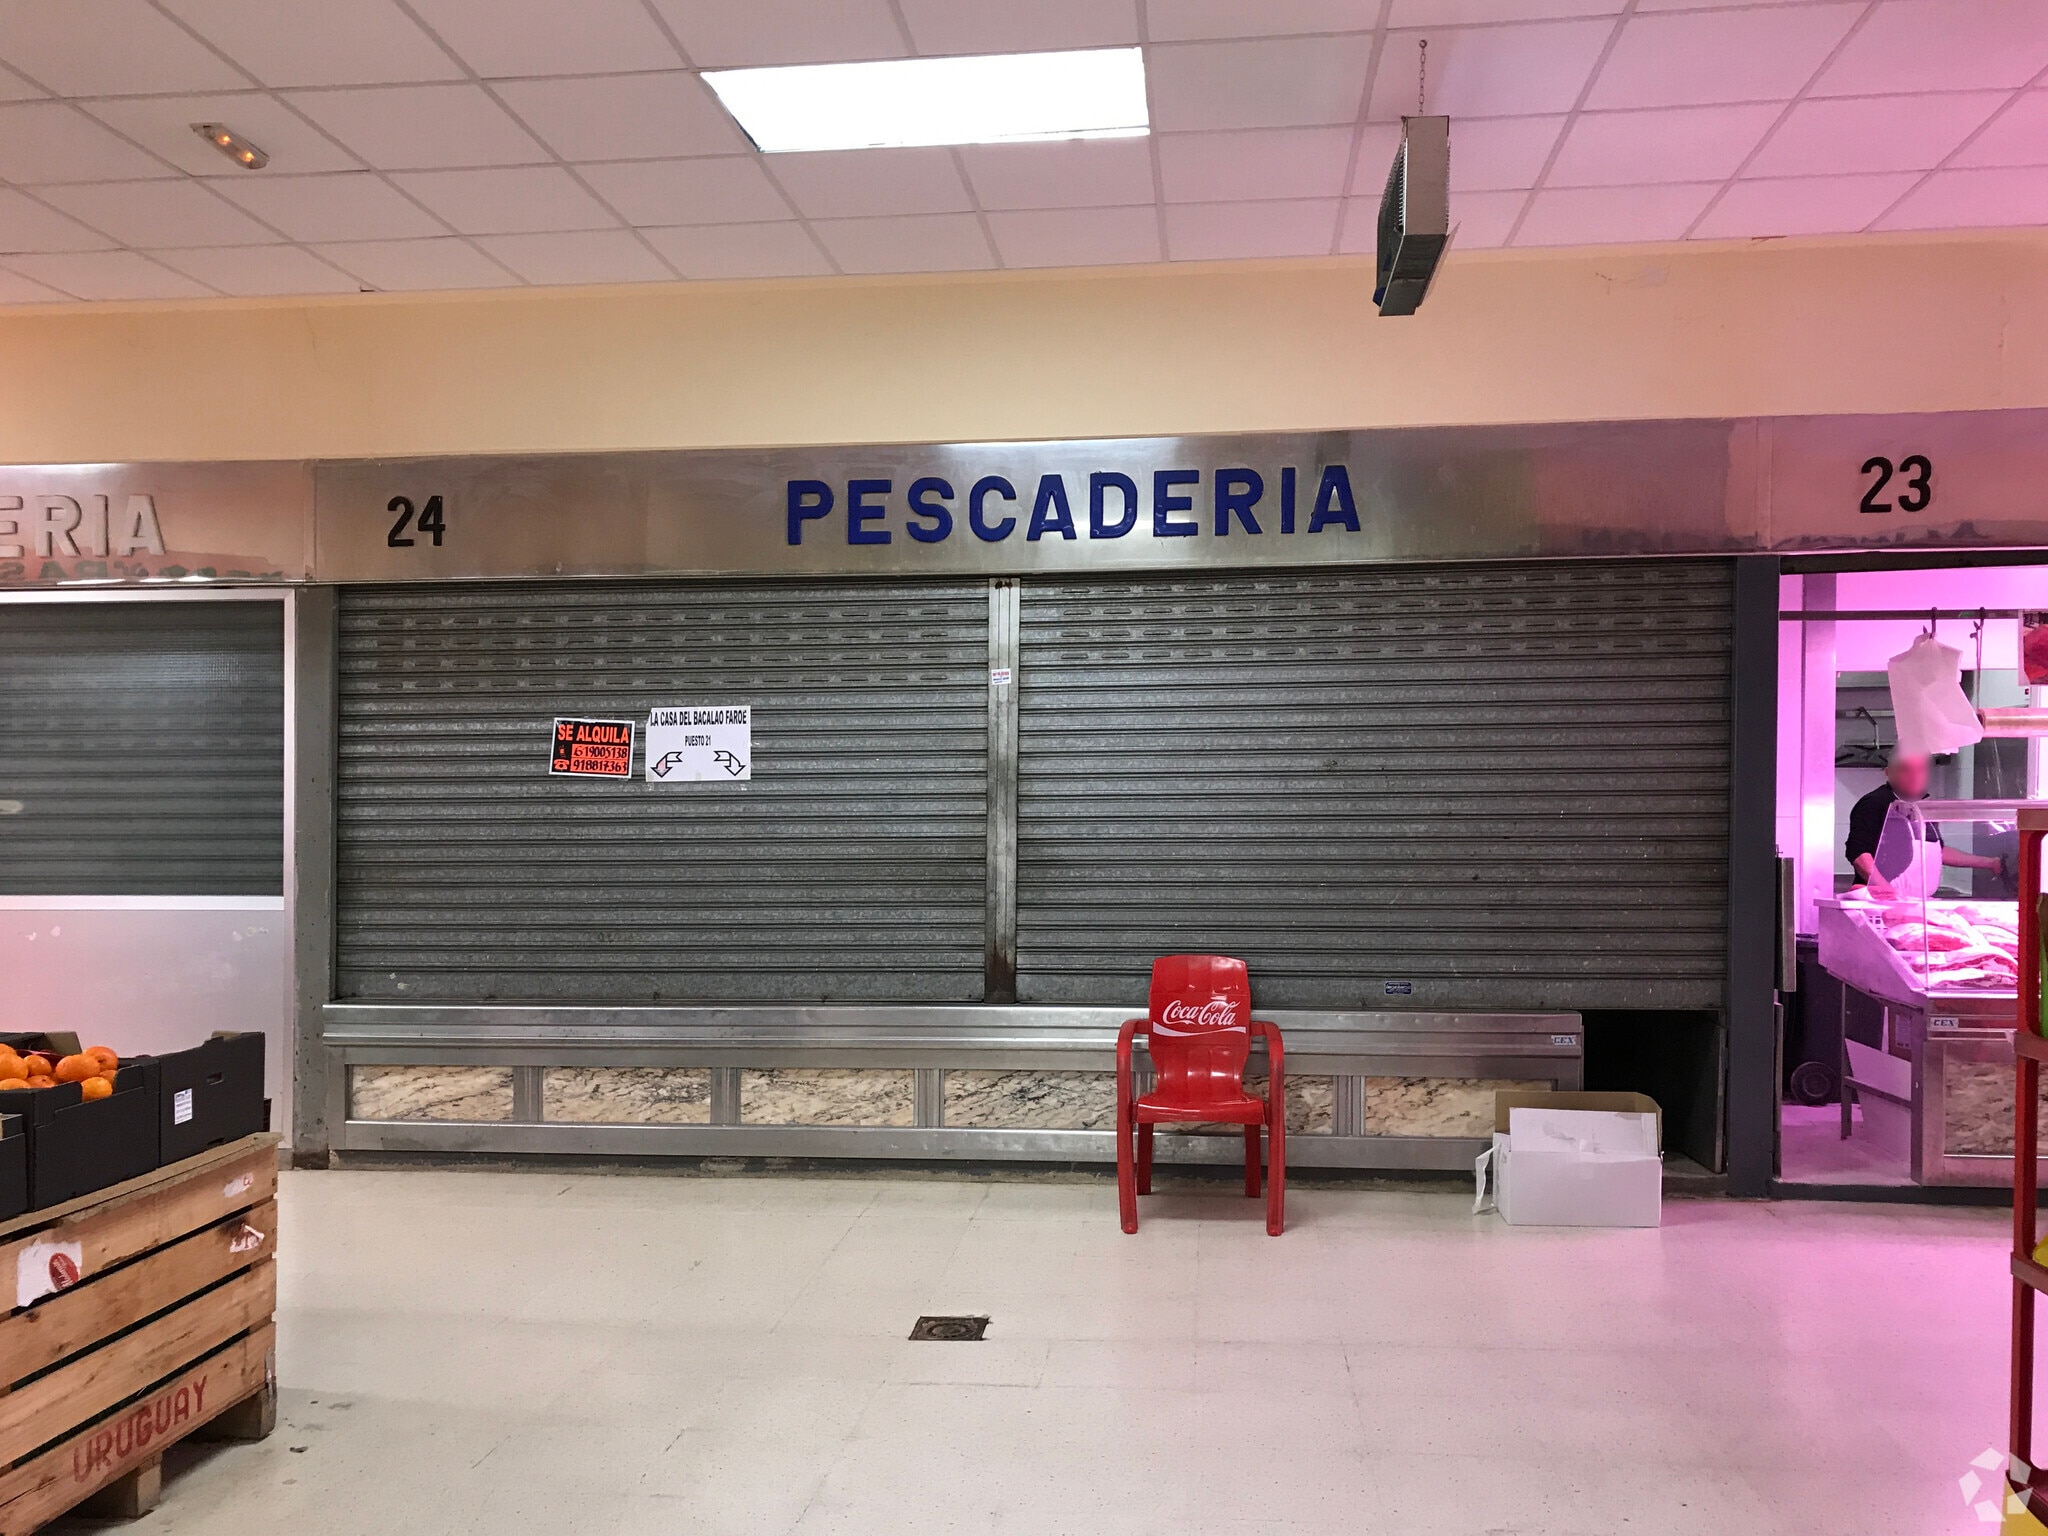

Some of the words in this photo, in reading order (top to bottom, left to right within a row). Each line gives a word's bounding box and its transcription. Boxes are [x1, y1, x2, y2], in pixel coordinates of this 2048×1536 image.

[1860, 454, 1931, 513] 23
[387, 495, 446, 547] 24
[787, 464, 1361, 546] PESCADERIA
[557, 723, 574, 741] SE
[576, 725, 629, 743] ALQUILA
[650, 711, 659, 726] LA
[660, 711, 678, 726] CASA
[679, 710, 692, 726] DEL
[693, 709, 724, 726] BACALAO
[684, 735, 704, 746] PUESTO
[705, 734, 711, 746] 21
[1162, 1000, 1241, 1026] Coca-Cola
[73, 1374, 208, 1484] URUGUAY
